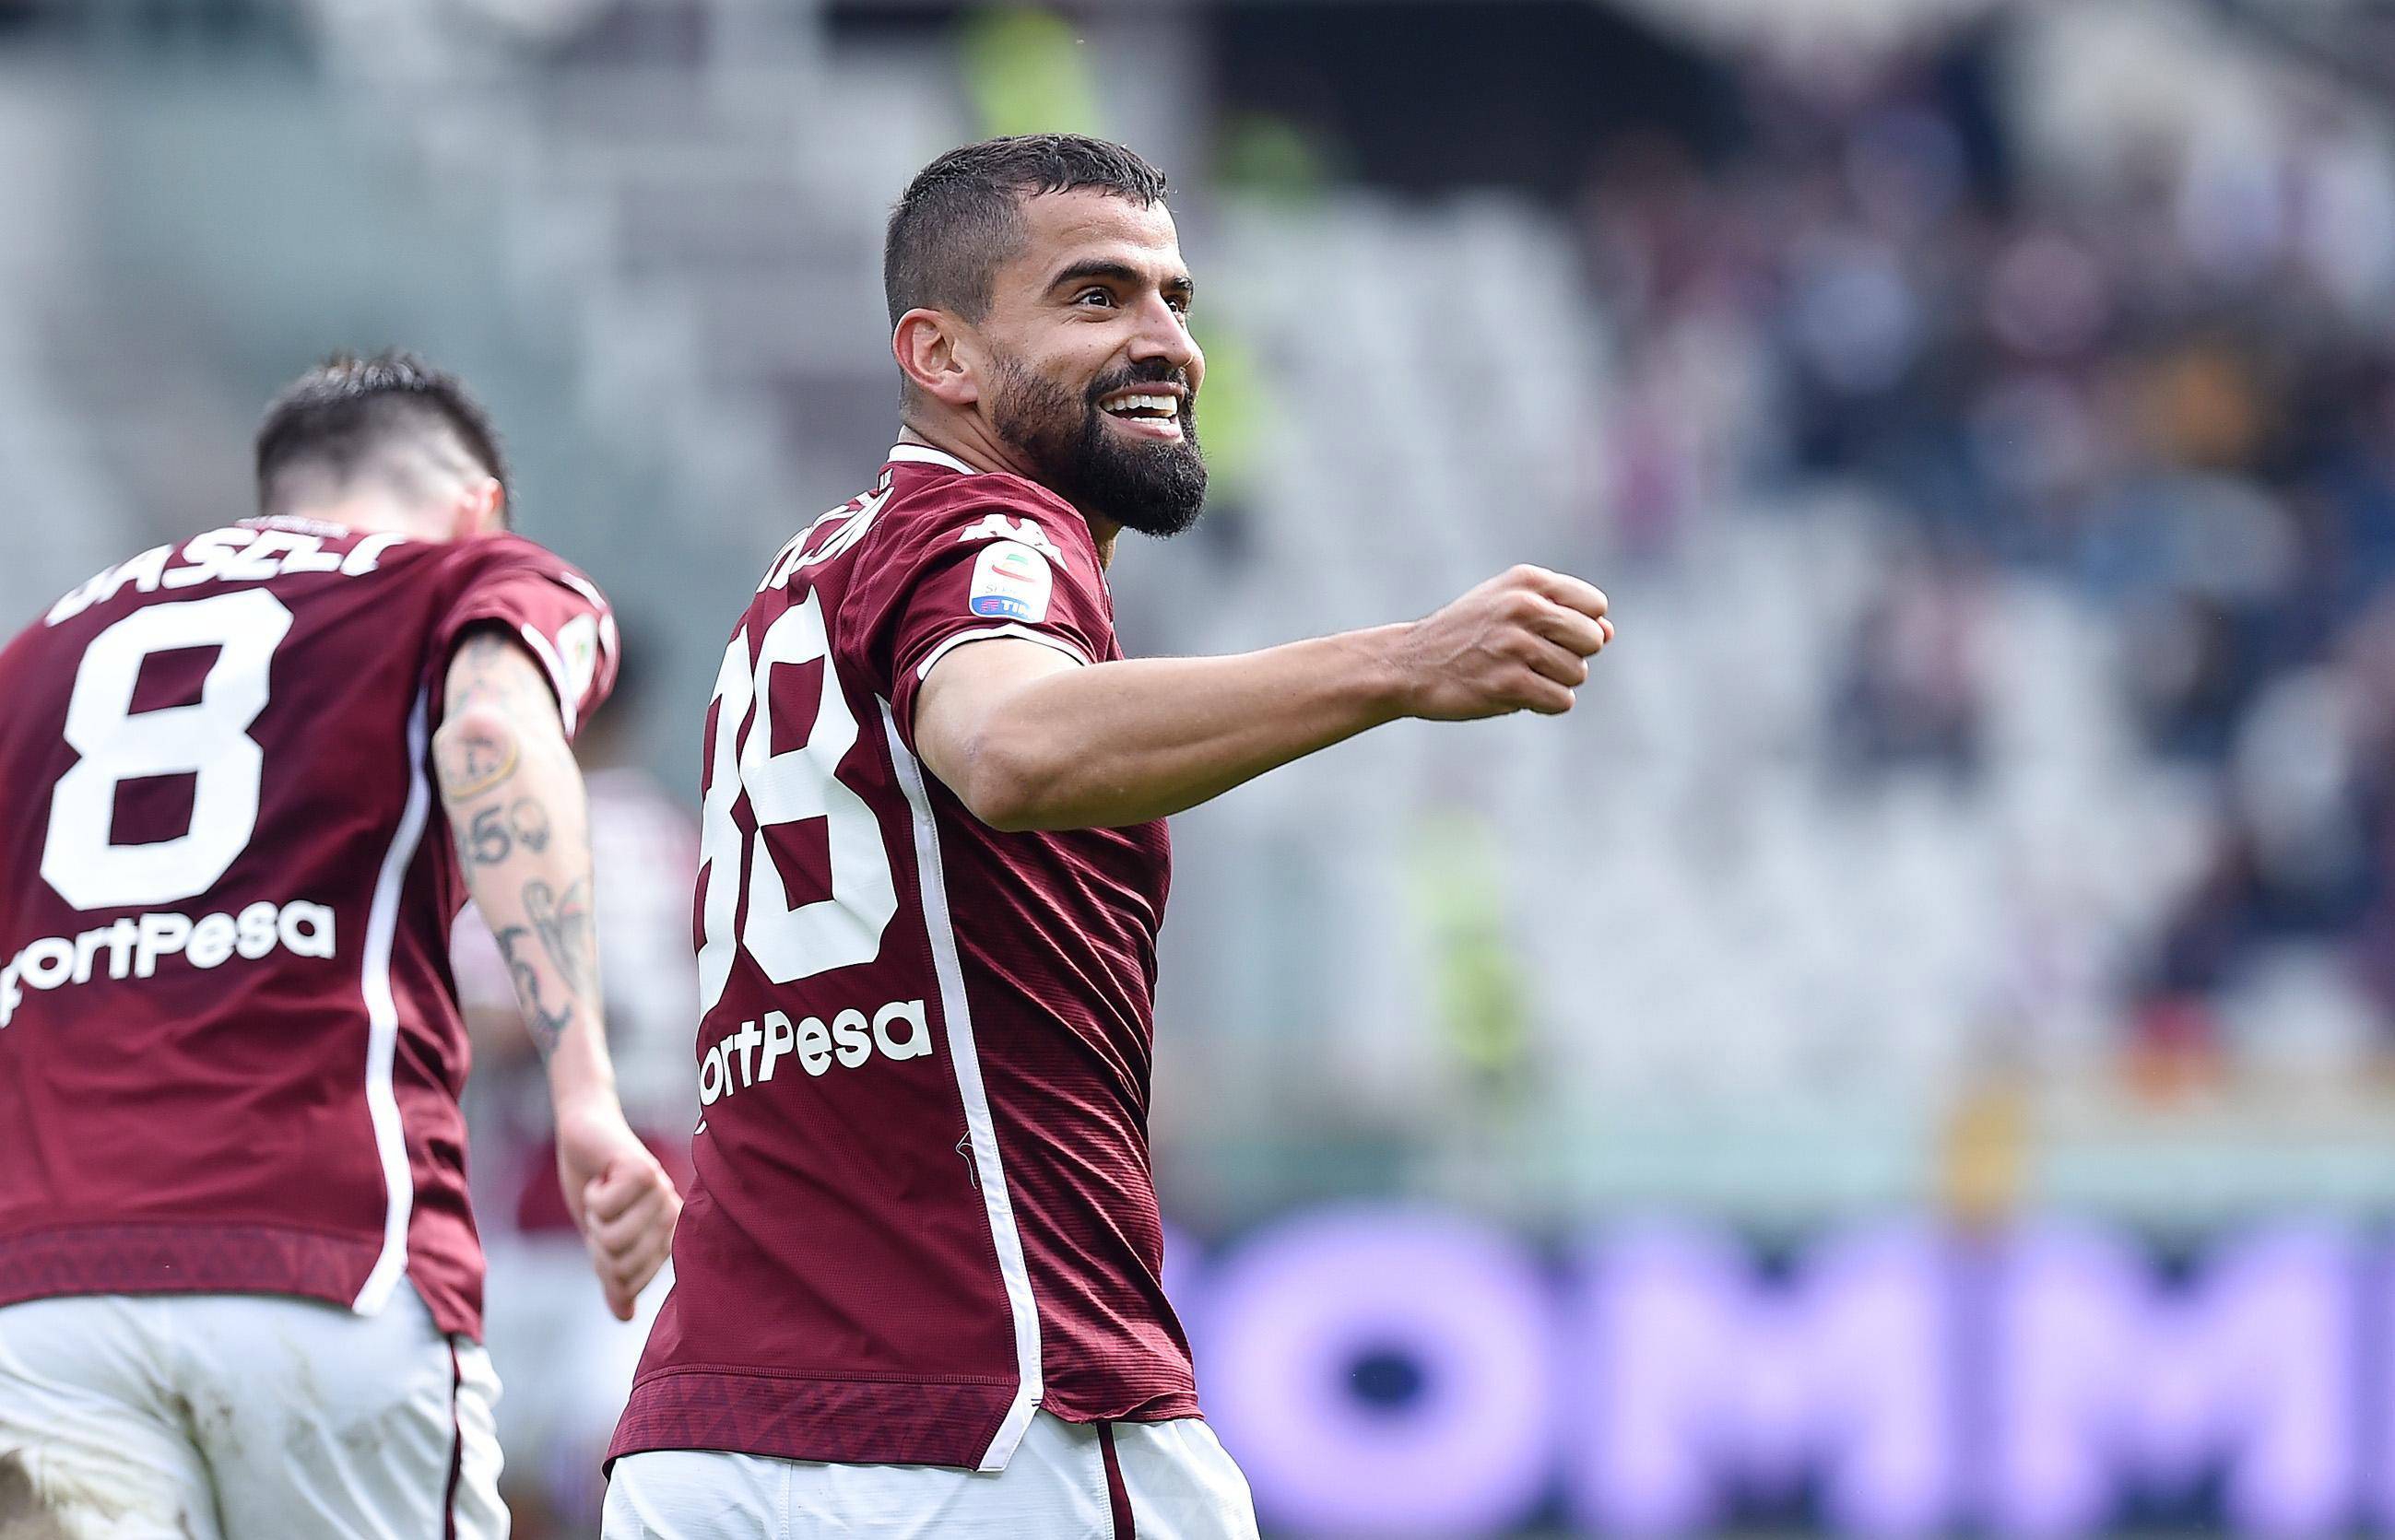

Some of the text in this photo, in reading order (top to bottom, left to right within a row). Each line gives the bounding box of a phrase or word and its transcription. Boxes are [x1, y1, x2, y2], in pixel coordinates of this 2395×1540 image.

[40, 587, 295, 911] 8
[696, 999, 934, 1134] ortPesa
[1171, 1198, 2369, 1540] OMM
